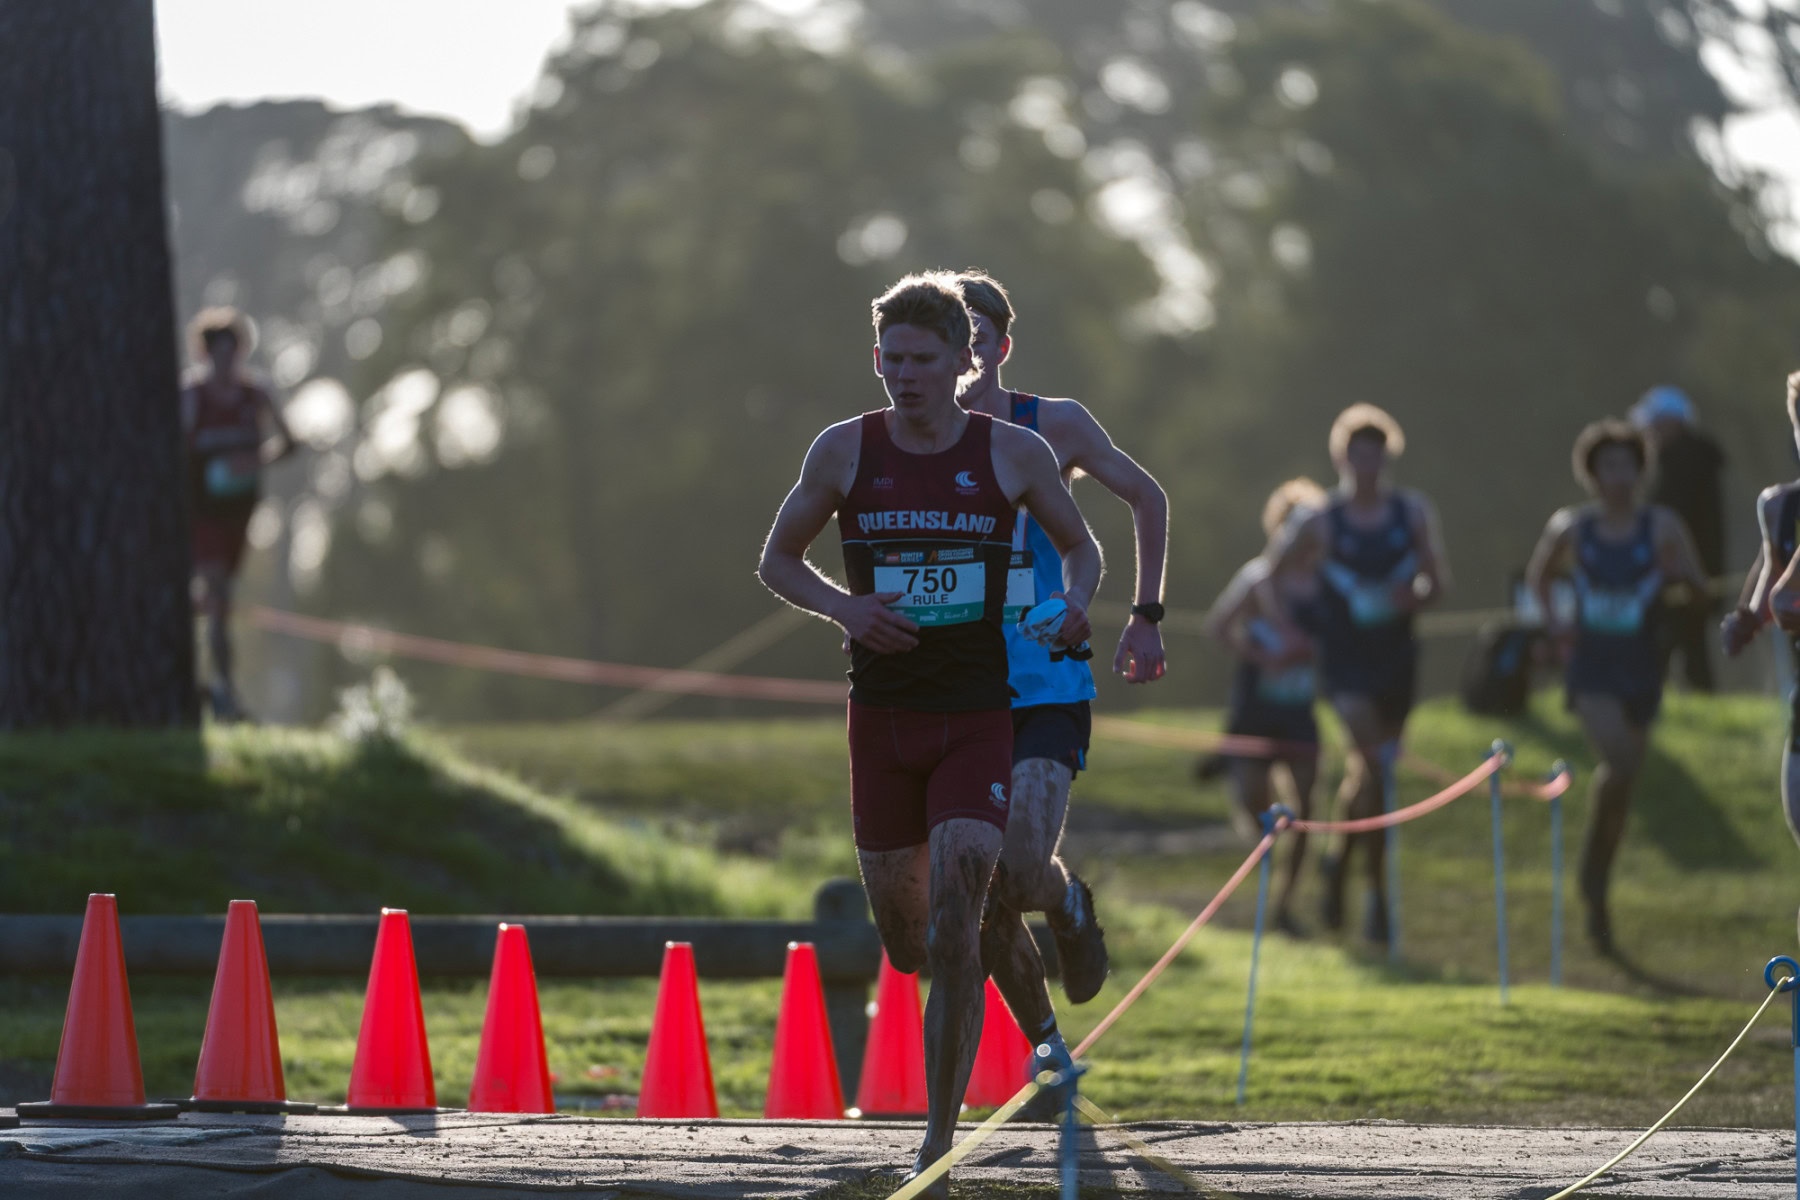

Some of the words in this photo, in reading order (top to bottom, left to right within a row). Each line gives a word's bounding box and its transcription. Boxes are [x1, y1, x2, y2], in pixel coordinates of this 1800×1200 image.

[857, 510, 996, 534] QUEENSLAND
[903, 567, 957, 594] 750
[913, 594, 949, 605] RULE
